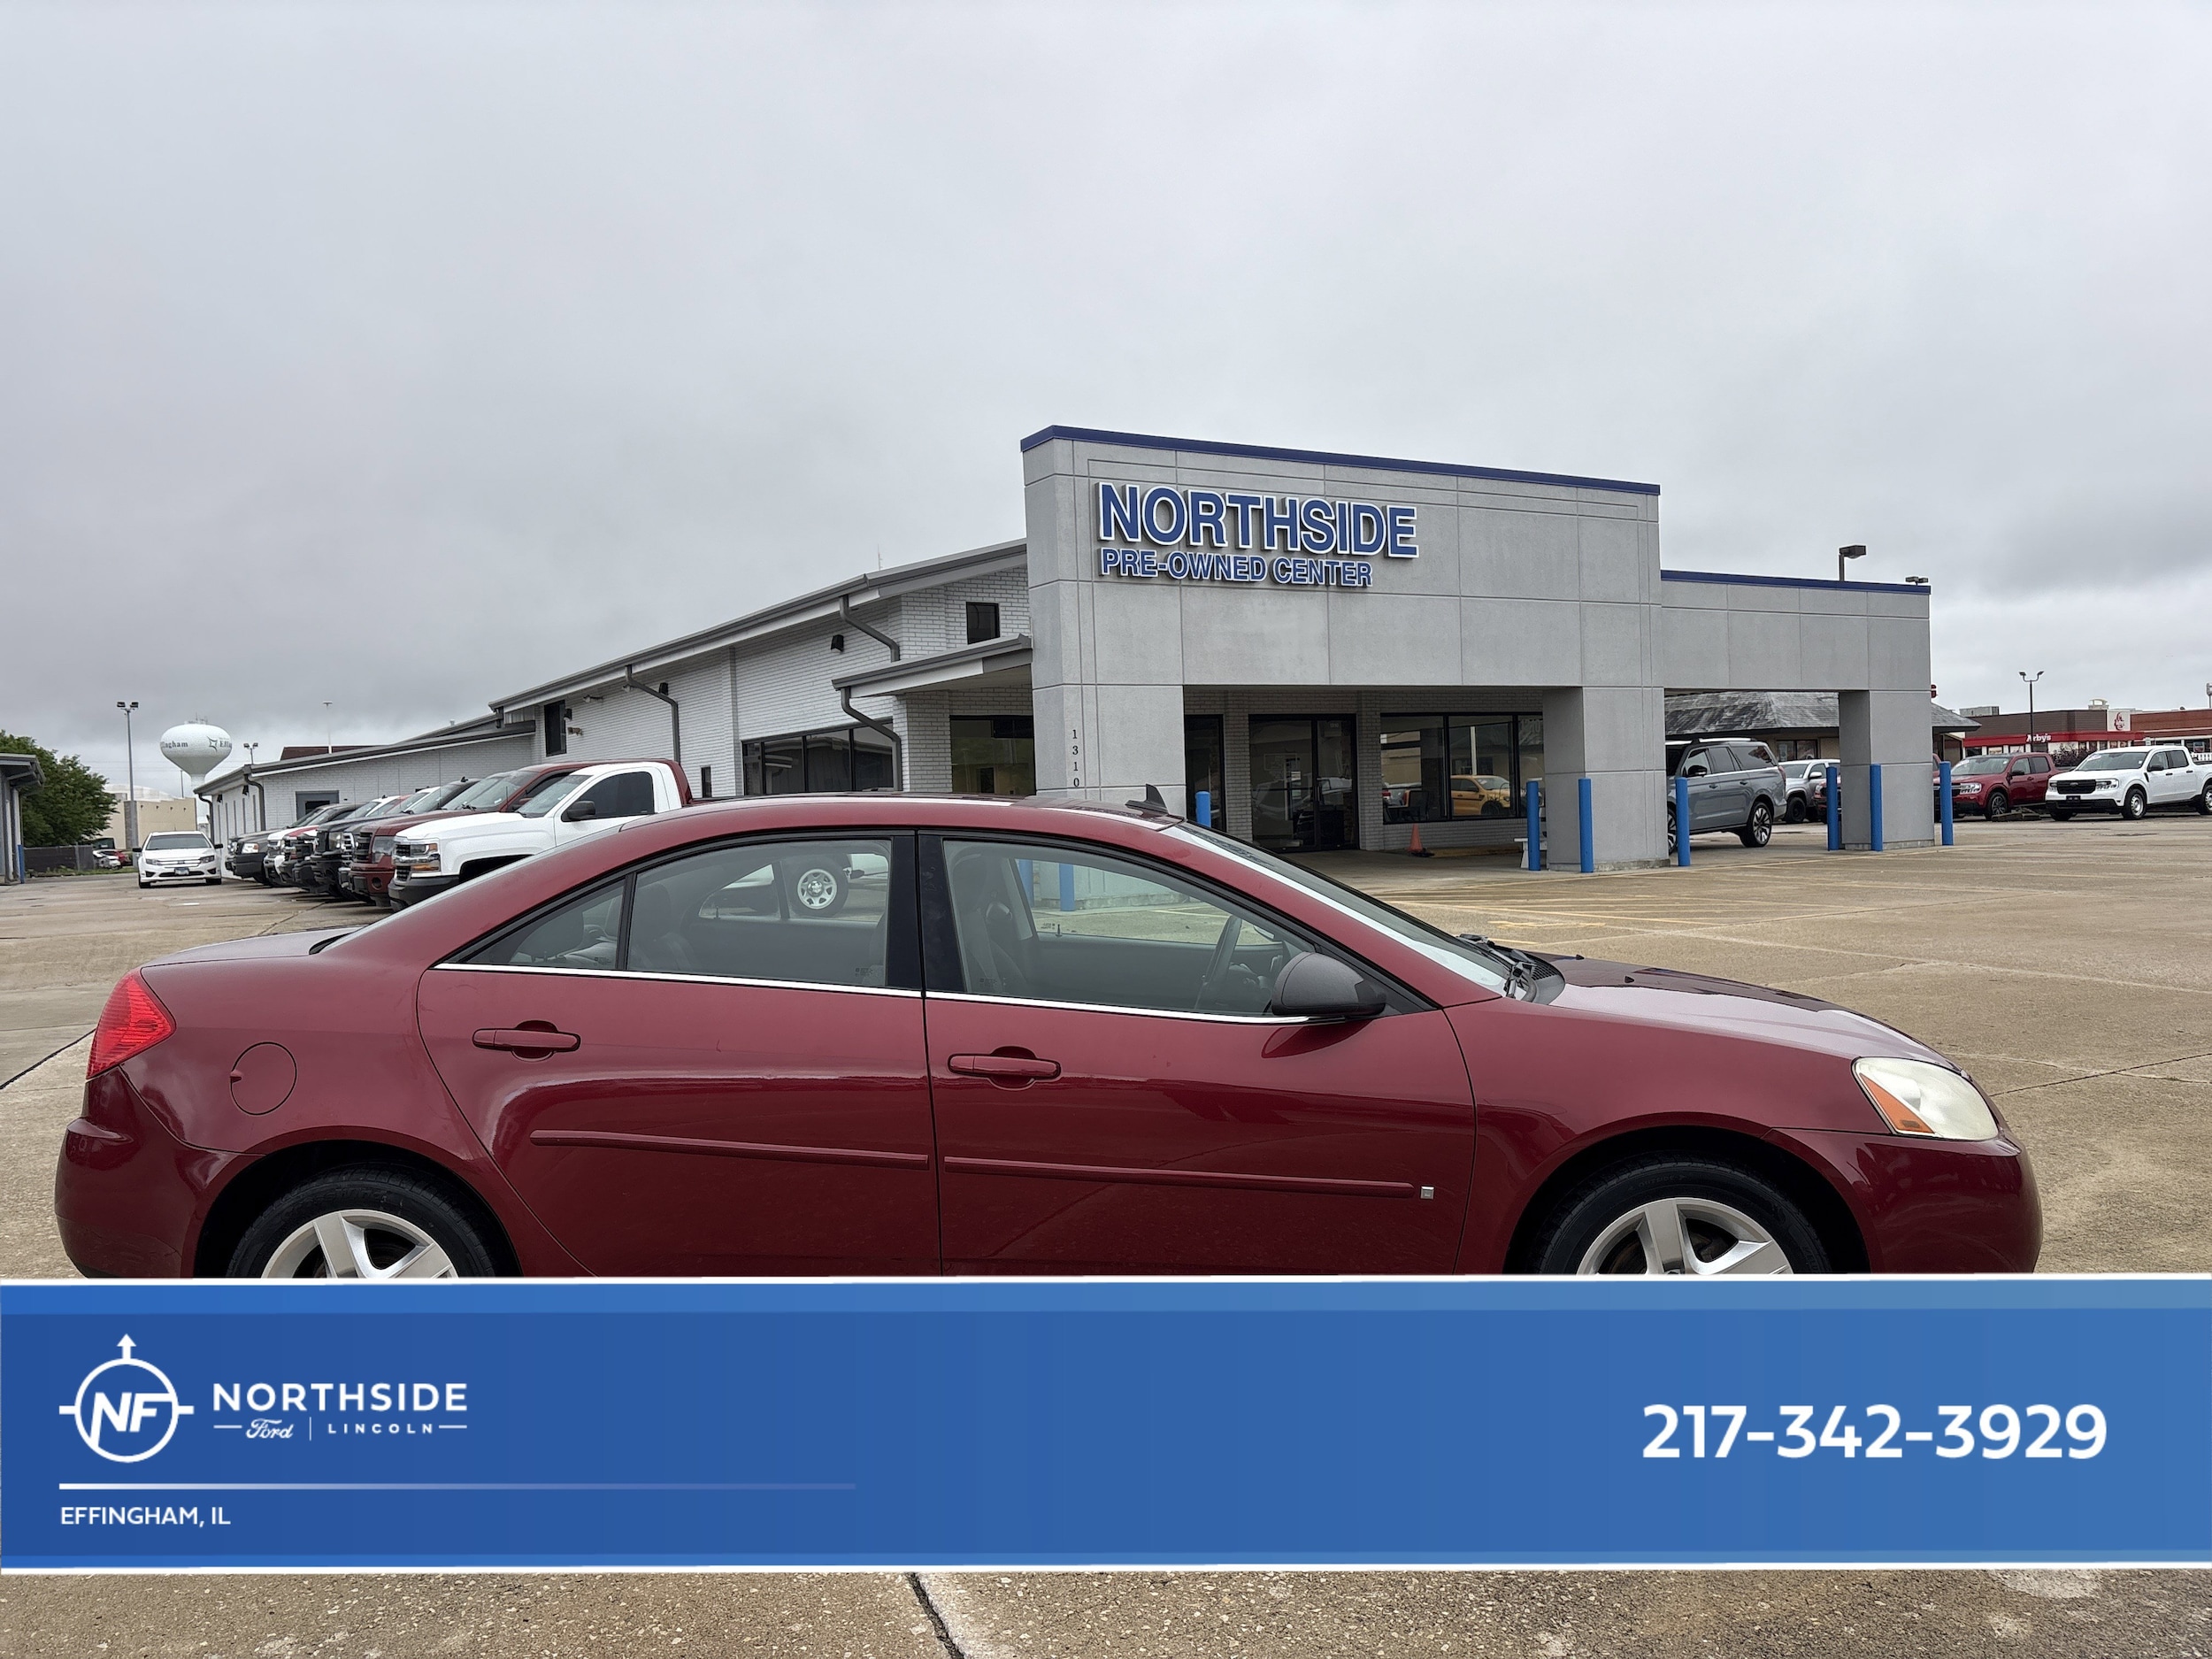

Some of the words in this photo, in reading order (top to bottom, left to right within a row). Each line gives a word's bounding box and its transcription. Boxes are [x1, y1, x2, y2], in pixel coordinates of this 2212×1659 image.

[1096, 481, 1419, 558] NORTHSIDE
[1099, 547, 1268, 583] PRE-OWNED
[1271, 556, 1373, 588] CENTER
[1071, 728, 1080, 787] 1310
[2025, 733, 2052, 743] Arby's
